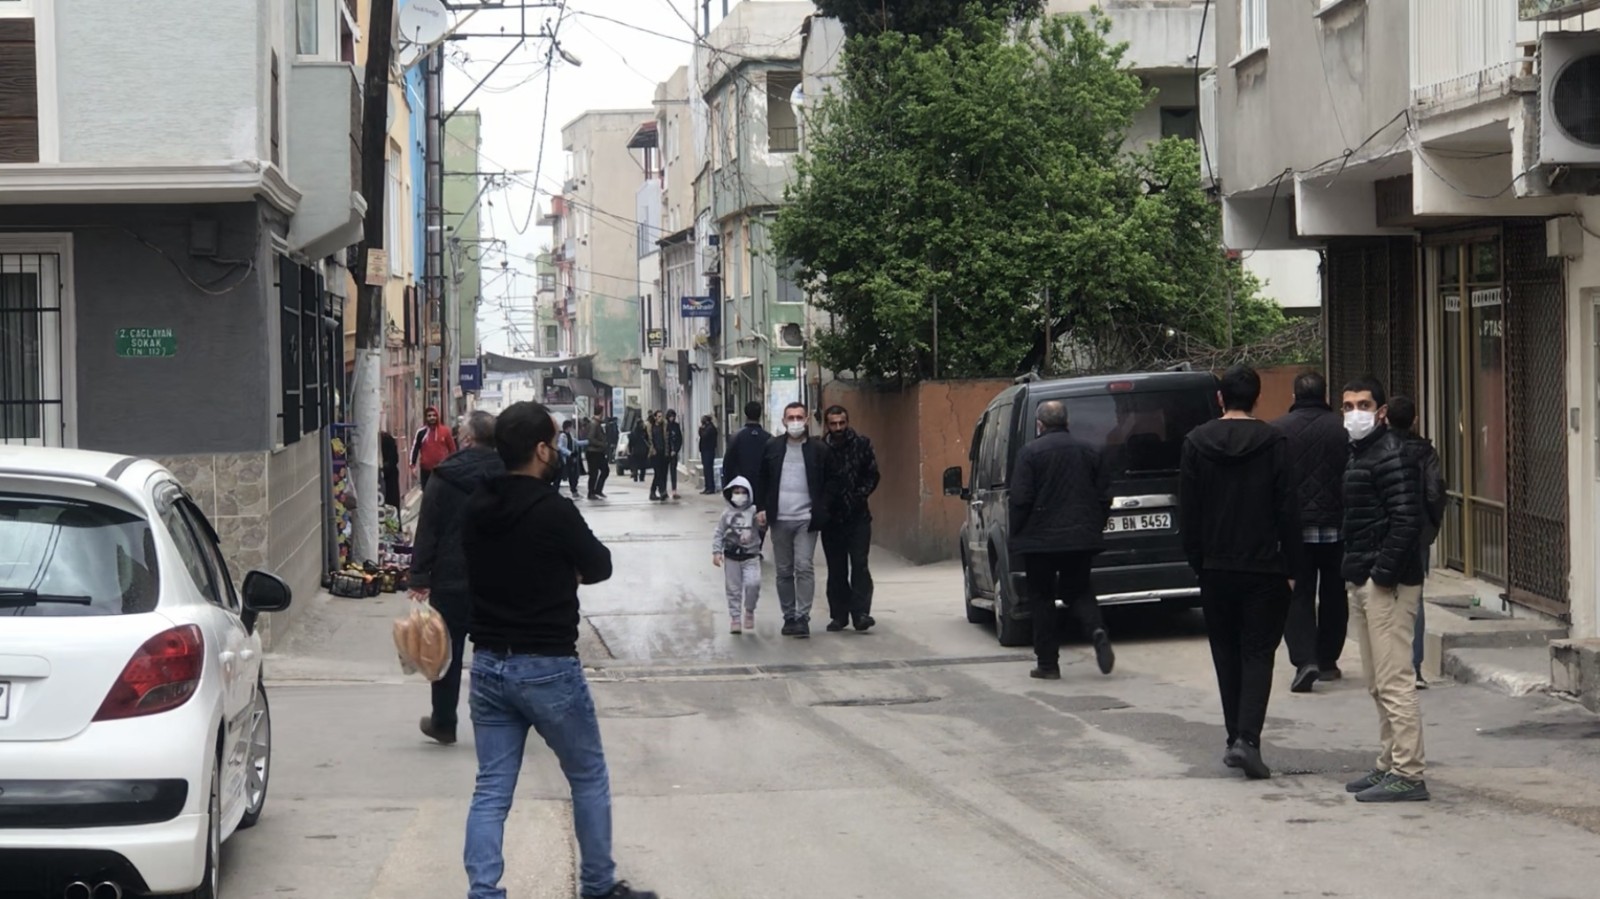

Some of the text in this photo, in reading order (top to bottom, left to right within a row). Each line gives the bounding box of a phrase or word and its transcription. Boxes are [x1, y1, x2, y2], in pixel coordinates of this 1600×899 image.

[131, 339, 161, 347] SOKAK
[1122, 517, 1137, 530] BN
[1141, 514, 1169, 528] 5452
